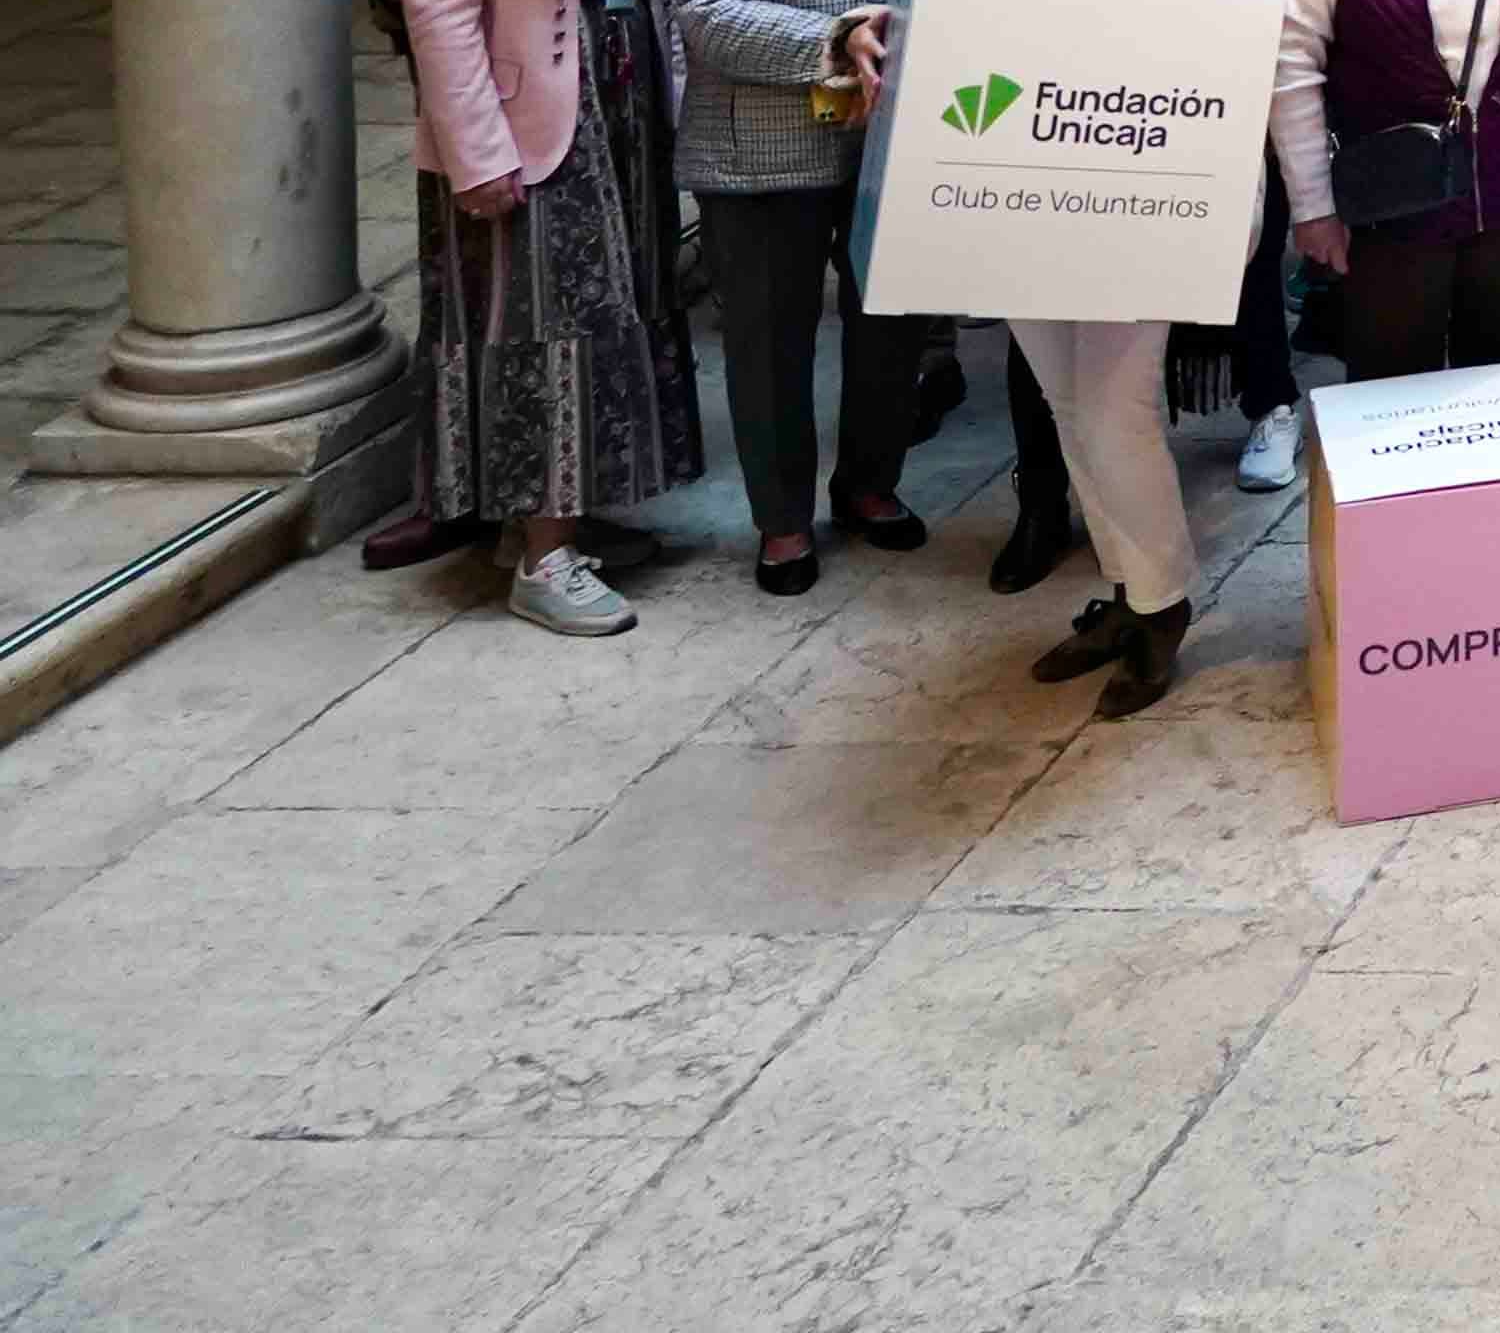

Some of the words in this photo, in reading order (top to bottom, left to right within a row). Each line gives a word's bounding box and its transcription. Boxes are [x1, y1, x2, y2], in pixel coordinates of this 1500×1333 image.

[1035, 81, 1226, 120] Fundación
[1031, 113, 1168, 156] Unicaja
[930, 183, 998, 210] Club
[1005, 187, 1042, 212] de
[1049, 189, 1210, 219] Voluntarios
